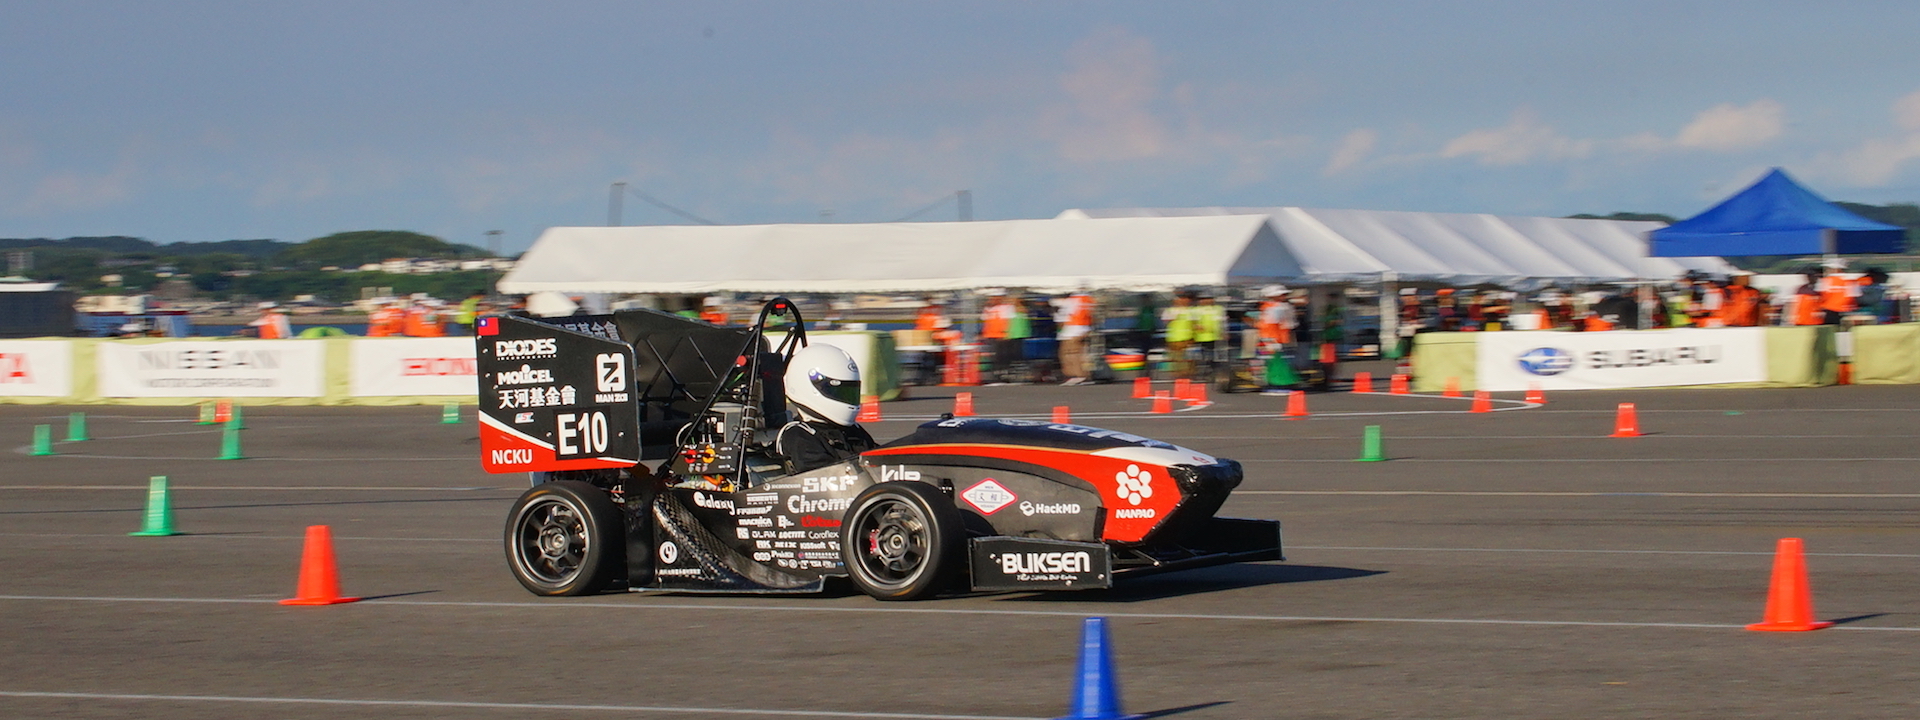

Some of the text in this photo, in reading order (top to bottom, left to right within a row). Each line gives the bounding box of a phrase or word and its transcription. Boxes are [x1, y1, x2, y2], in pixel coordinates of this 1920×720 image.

[495, 338, 557, 356] DIODES
[1586, 344, 1722, 370] SUBARU
[0, 353, 33, 384] A
[138, 349, 280, 370] NISSAN
[498, 385, 576, 409] 天河基金會
[557, 411, 608, 455] E10
[492, 449, 533, 464] NCKU
[802, 475, 859, 493] SKF
[693, 491, 736, 515] Galaxy
[1036, 502, 1081, 515] HackMD
[1115, 509, 1156, 519] NANPAO
